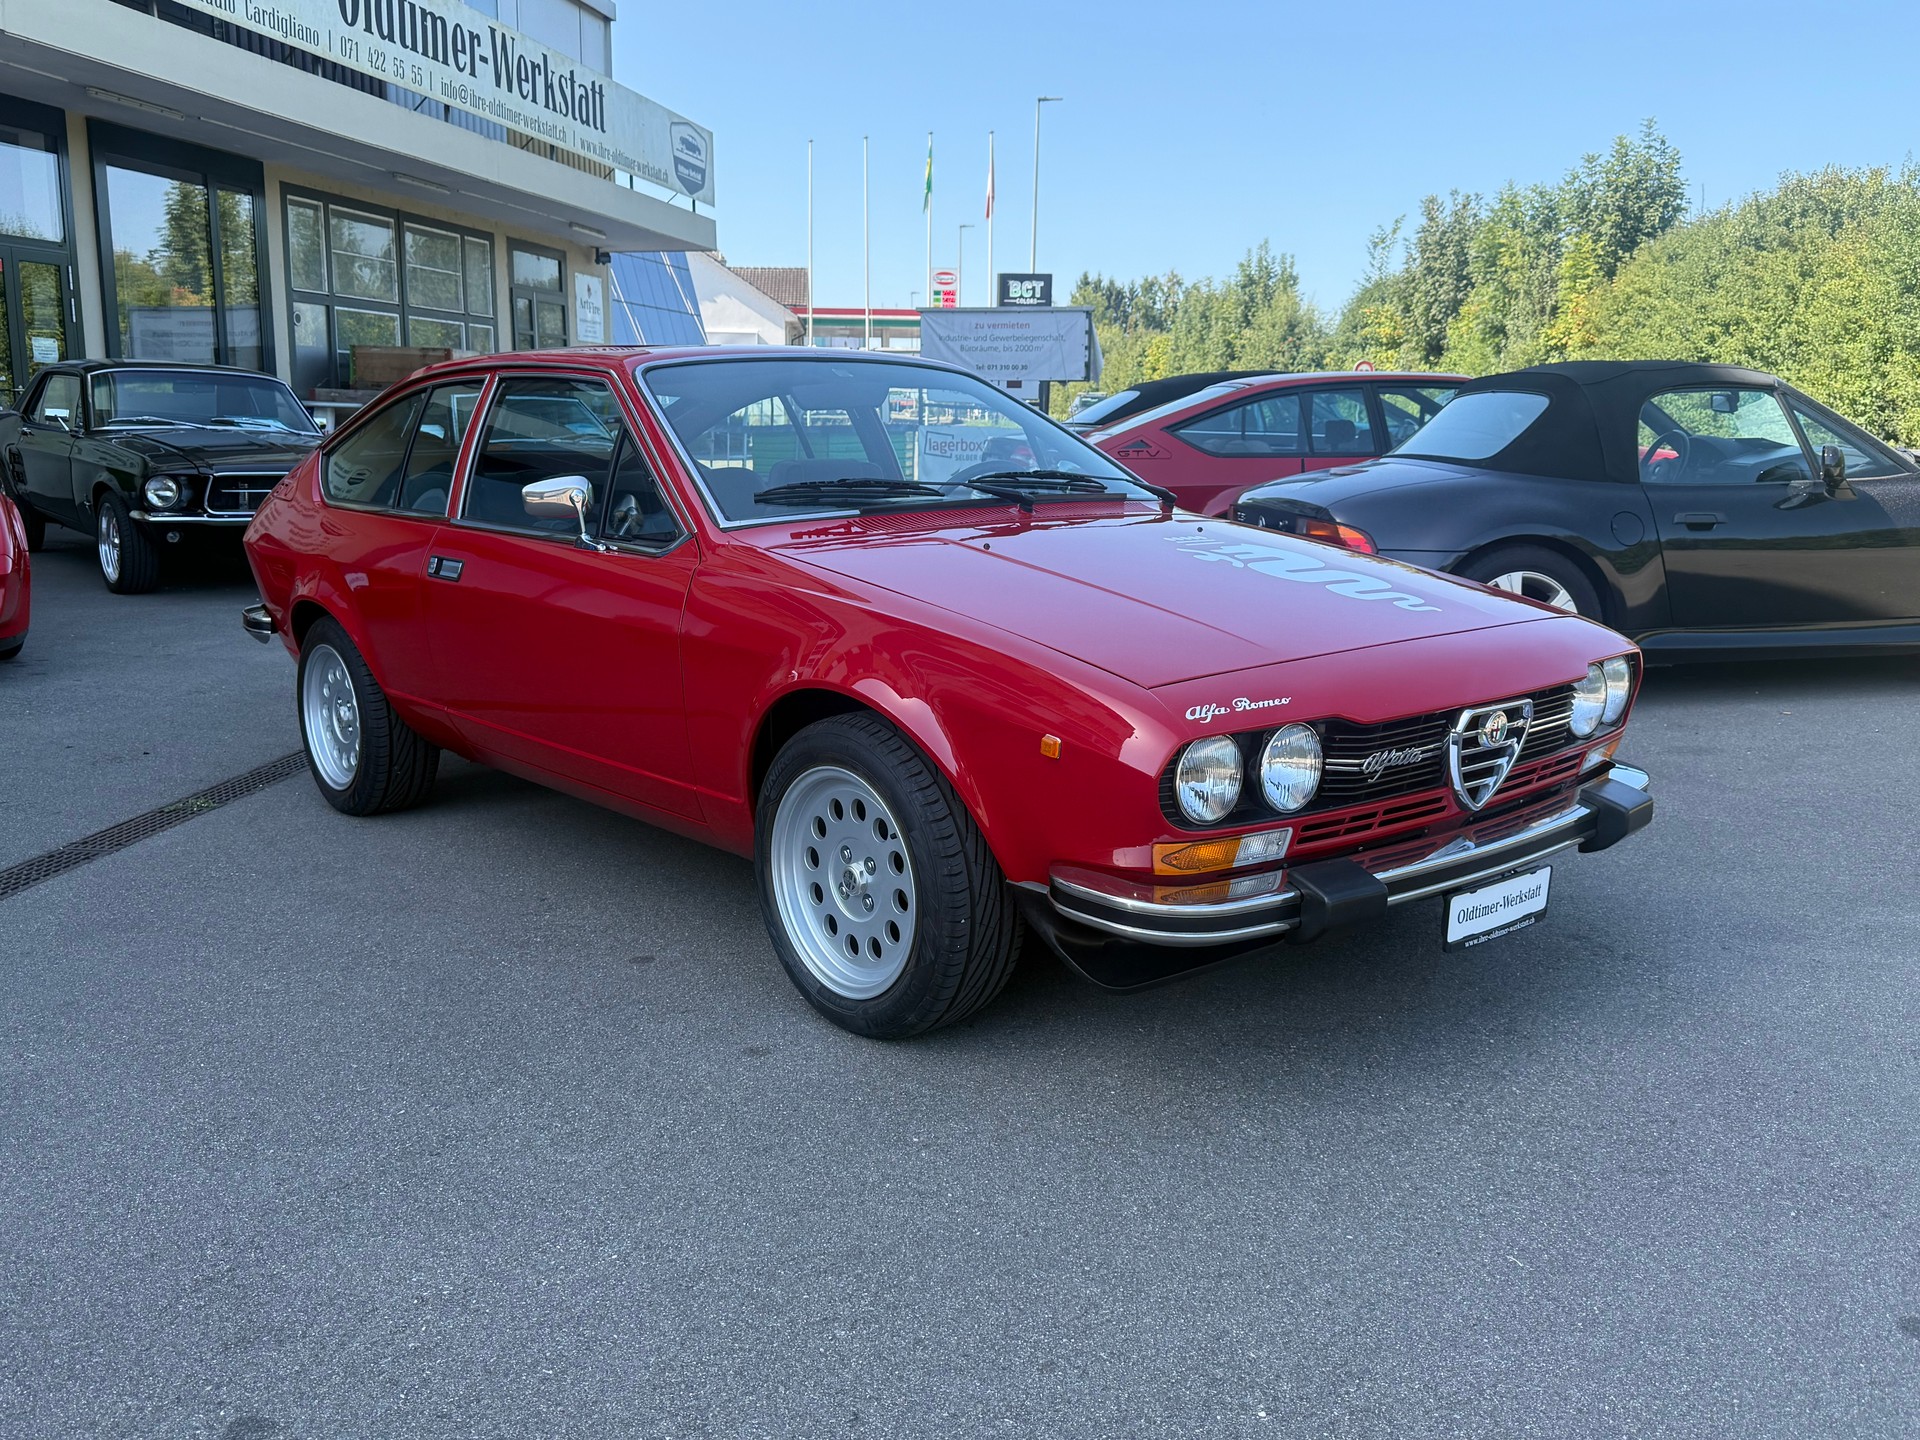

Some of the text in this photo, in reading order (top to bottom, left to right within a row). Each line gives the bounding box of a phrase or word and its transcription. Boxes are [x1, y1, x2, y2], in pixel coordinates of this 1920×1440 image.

[245, 0, 319, 47] Cardigliano
[340, 35, 359, 62] 071
[367, 46, 386, 73] 422
[392, 58, 405, 80] 55
[411, 64, 424, 87] 55
[1007, 279, 1045, 298] BCT
[973, 333, 987, 342] und
[987, 321, 1030, 330] vermieten
[1185, 697, 1292, 723] Alfa Romeo
[1363, 747, 1423, 783] Alfetta
[1457, 884, 1542, 924] Oldtimer-Werkstatt
